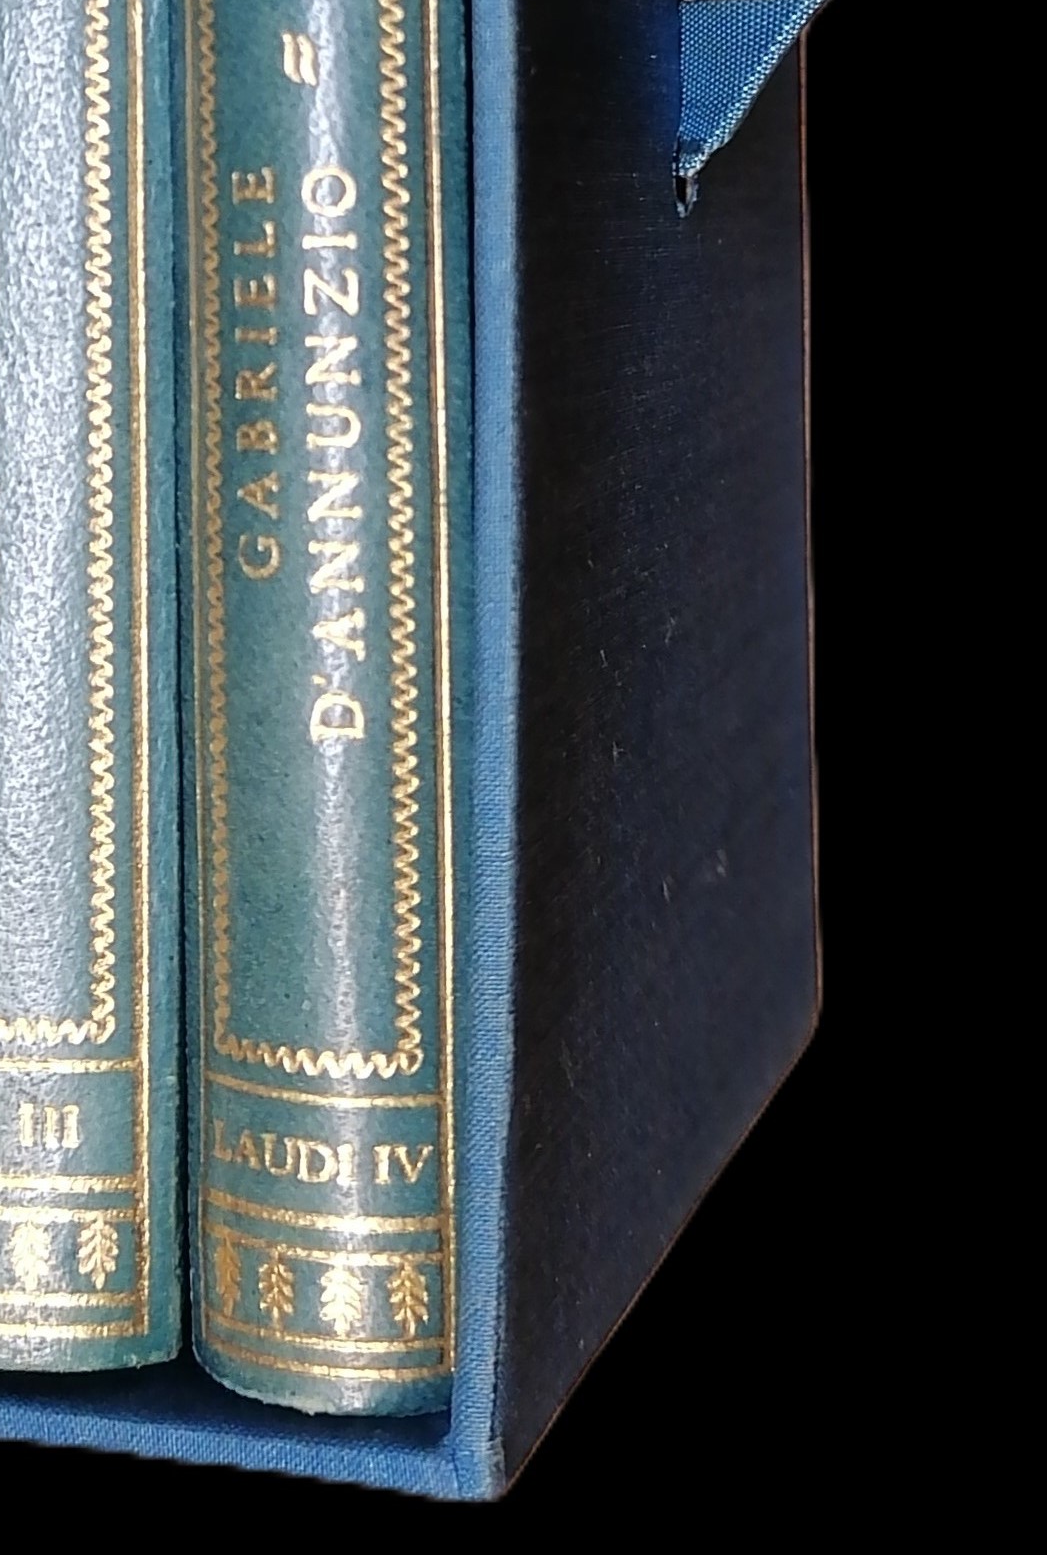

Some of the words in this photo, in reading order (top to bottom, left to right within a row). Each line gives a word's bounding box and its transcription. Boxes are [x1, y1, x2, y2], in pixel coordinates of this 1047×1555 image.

[233, 166, 281, 580] GABRIELE
[301, 164, 365, 744] D'ANNUNZIO
[18, 1104, 80, 1149] III
[213, 1119, 355, 1185] LAUDI
[373, 1144, 433, 1184] IV
